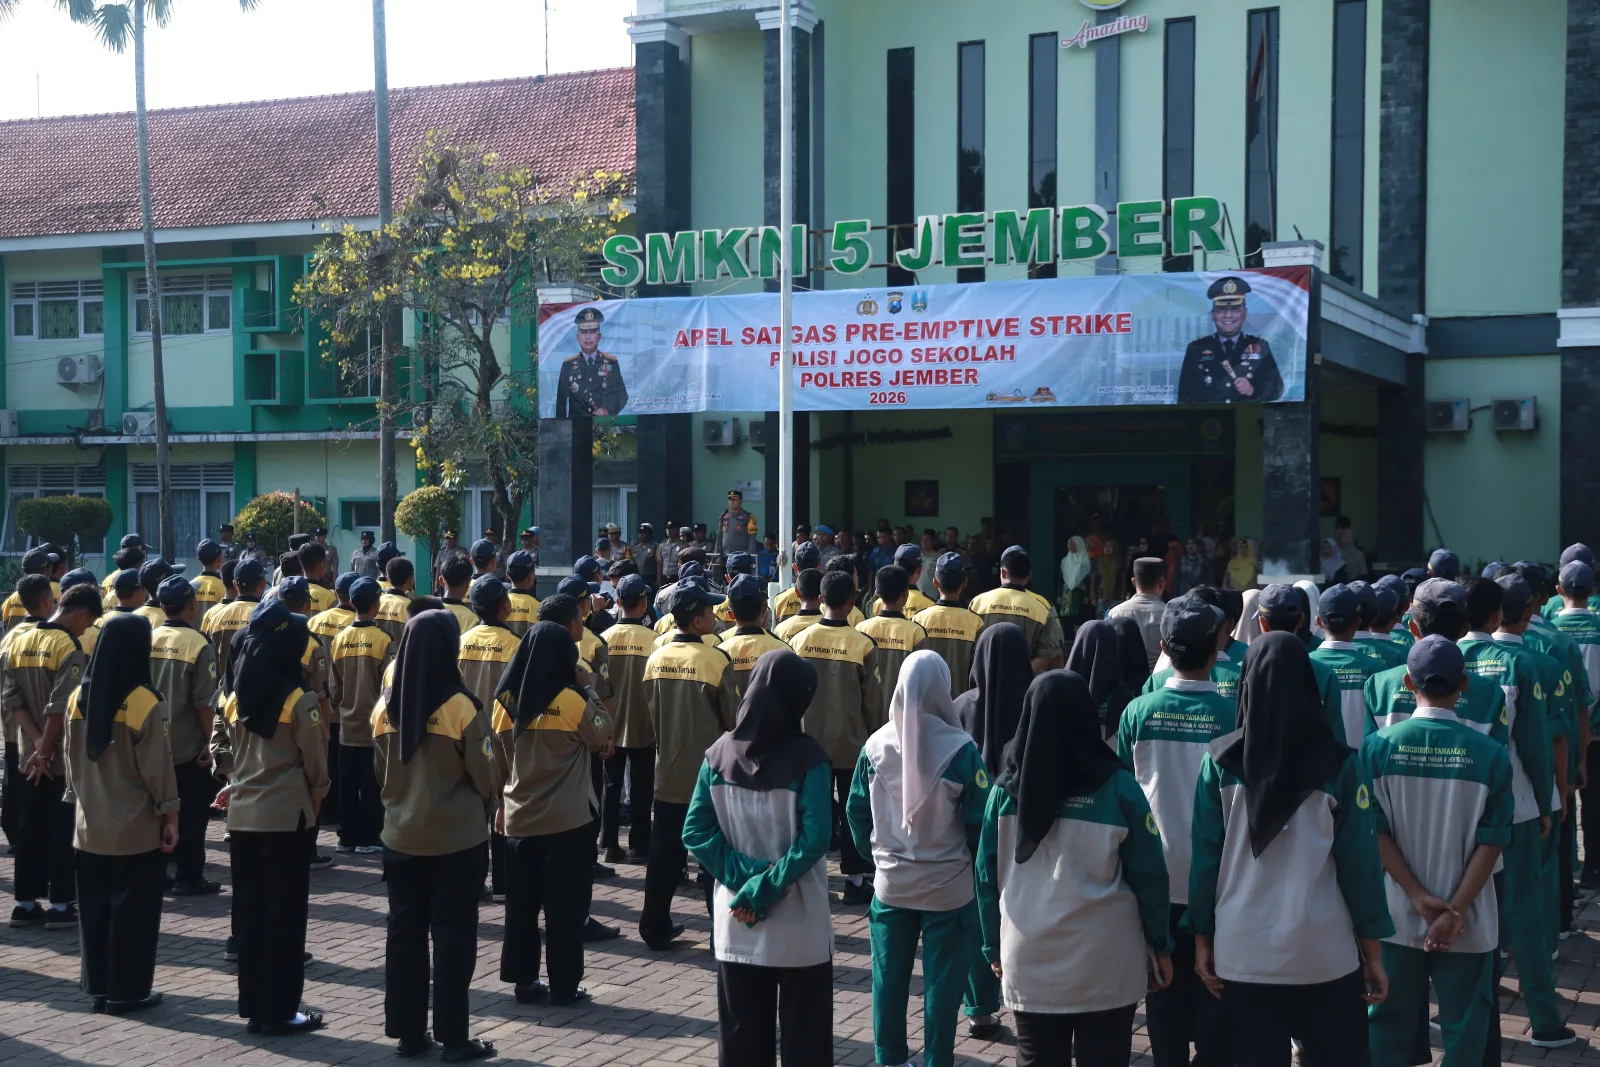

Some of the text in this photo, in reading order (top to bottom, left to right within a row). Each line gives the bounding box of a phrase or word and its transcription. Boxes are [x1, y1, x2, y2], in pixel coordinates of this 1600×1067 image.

[600, 196, 1229, 287] SMKN 5 JEMBER
[673, 312, 1133, 348] APEL SATGAS PRE-EMPTIVE STRIKE
[769, 344, 1015, 367] PLISI JOGO SEKOLAH
[800, 367, 980, 389] POLRES JEMBER
[869, 391, 907, 406] 2026
[804, 645, 847, 655] Agribisnis Ternak
